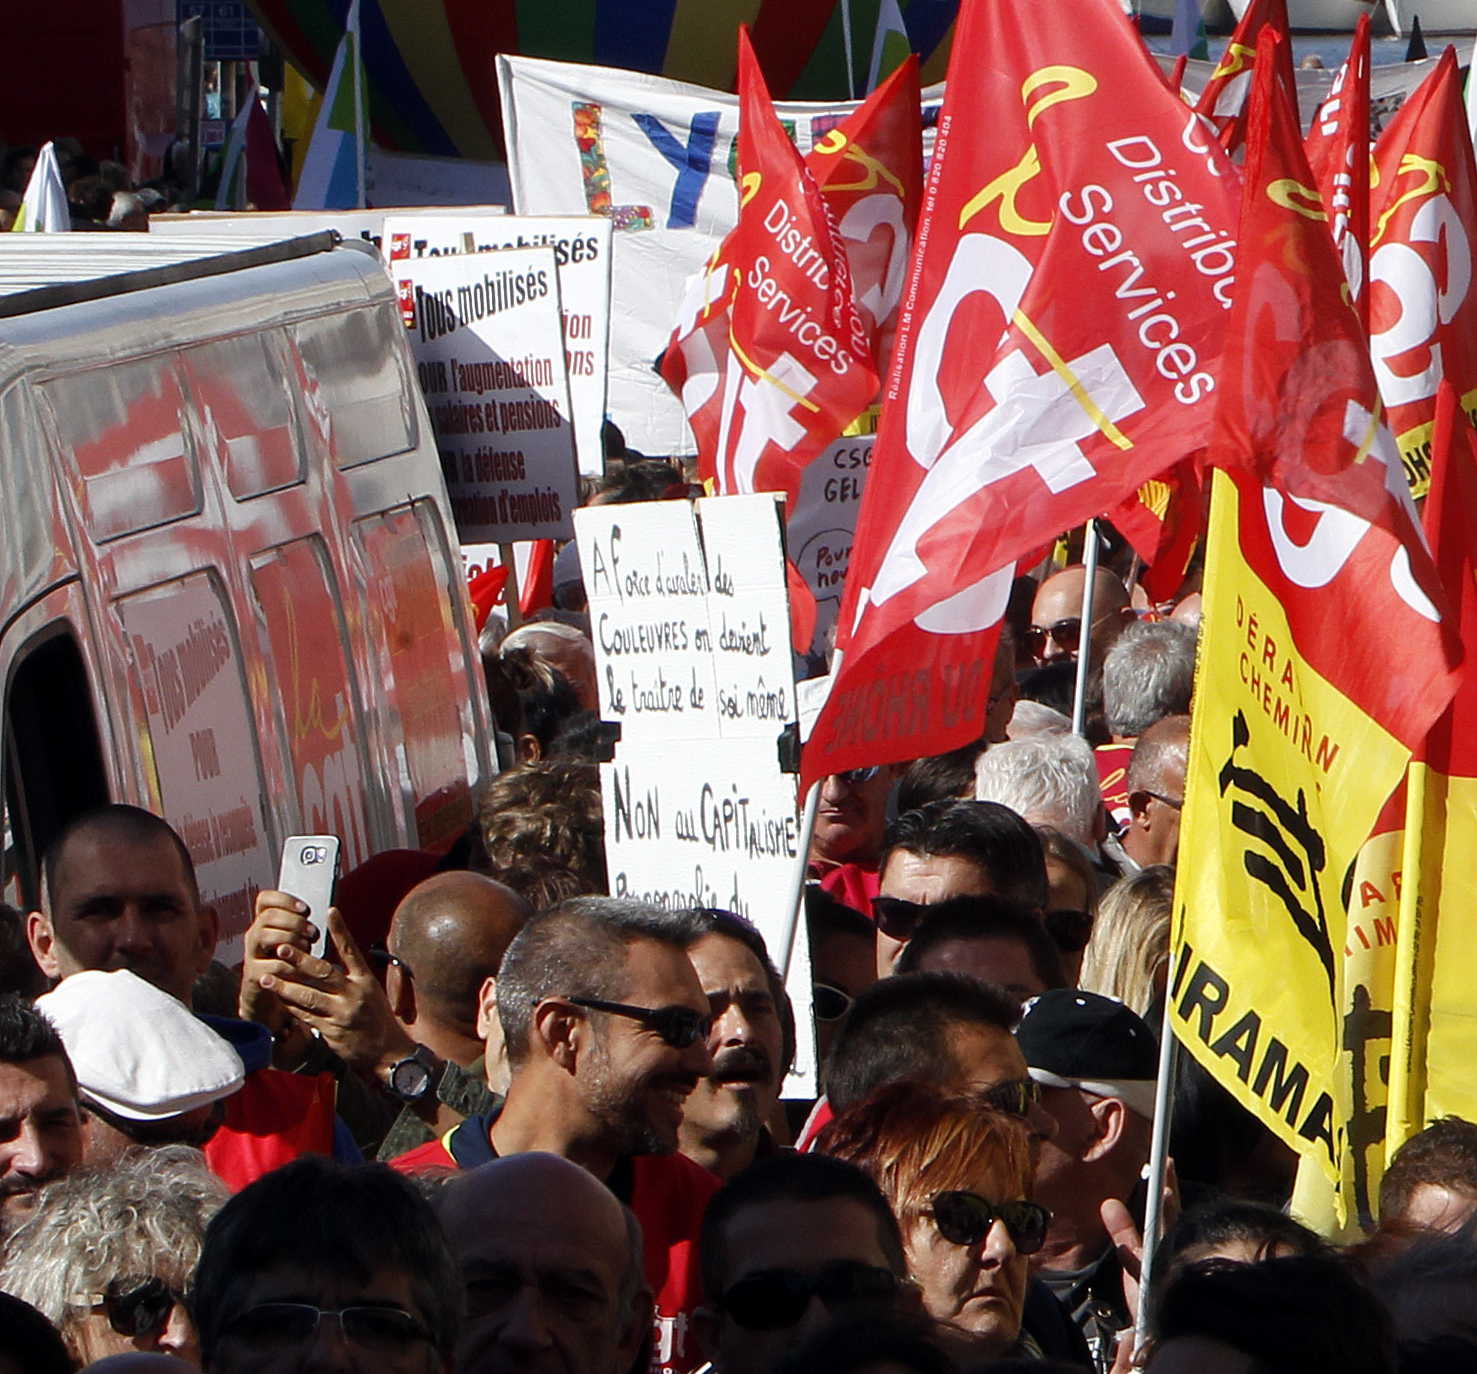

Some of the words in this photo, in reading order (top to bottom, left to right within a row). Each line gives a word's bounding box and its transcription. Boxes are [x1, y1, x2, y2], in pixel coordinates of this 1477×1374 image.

[414, 284, 456, 343] Tous
[458, 265, 549, 327] mobilisés
[747, 255, 853, 376] Services
[1058, 184, 1215, 404] Services
[451, 353, 554, 395] l'augmentation
[500, 398, 562, 436] pensions
[824, 478, 860, 503] GEL
[714, 554, 734, 598] des
[689, 667, 705, 709] de
[746, 676, 789, 721] même
[676, 804, 700, 844] au
[1171, 938, 1336, 1174] IRAMA
